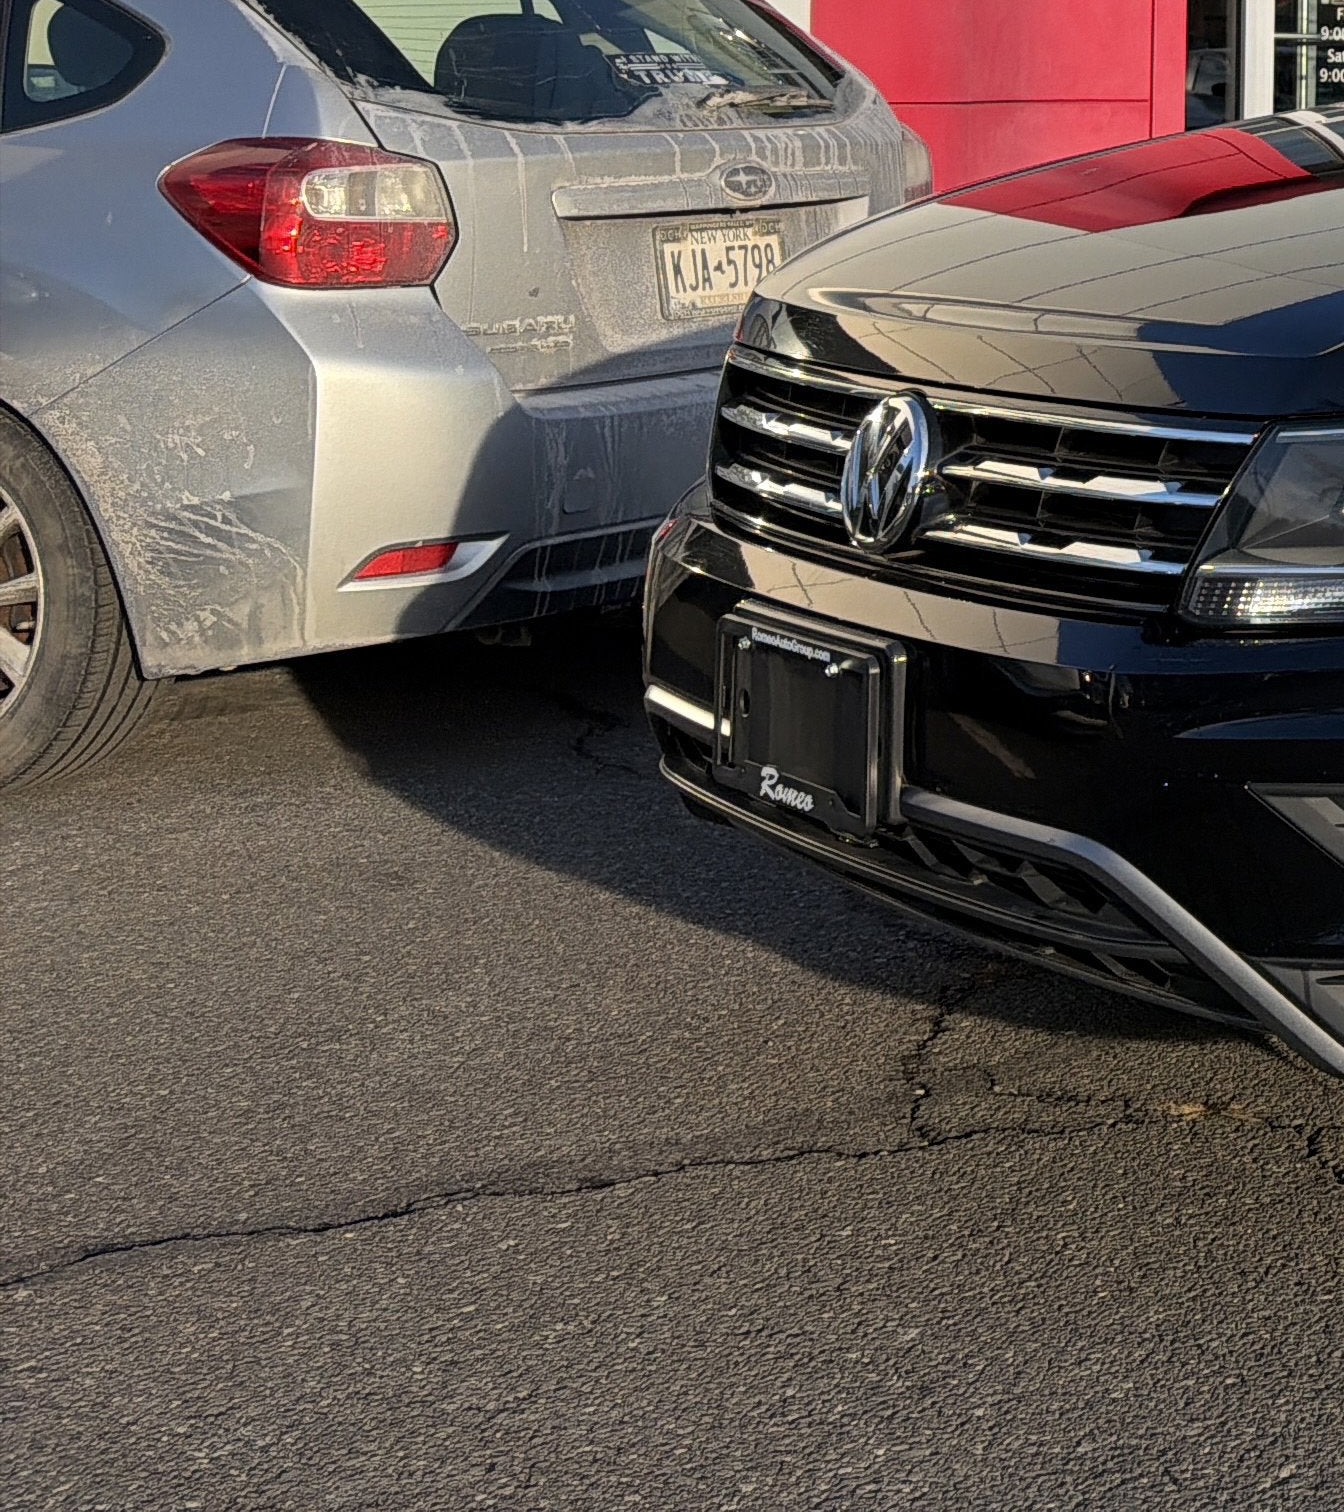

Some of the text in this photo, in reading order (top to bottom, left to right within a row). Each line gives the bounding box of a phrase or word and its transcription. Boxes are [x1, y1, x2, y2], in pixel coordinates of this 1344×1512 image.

[691, 227, 752, 246] NEW YORK
[670, 247, 713, 294] KJA
[460, 314, 576, 338] SUBARU
[760, 766, 815, 812] Romeo
